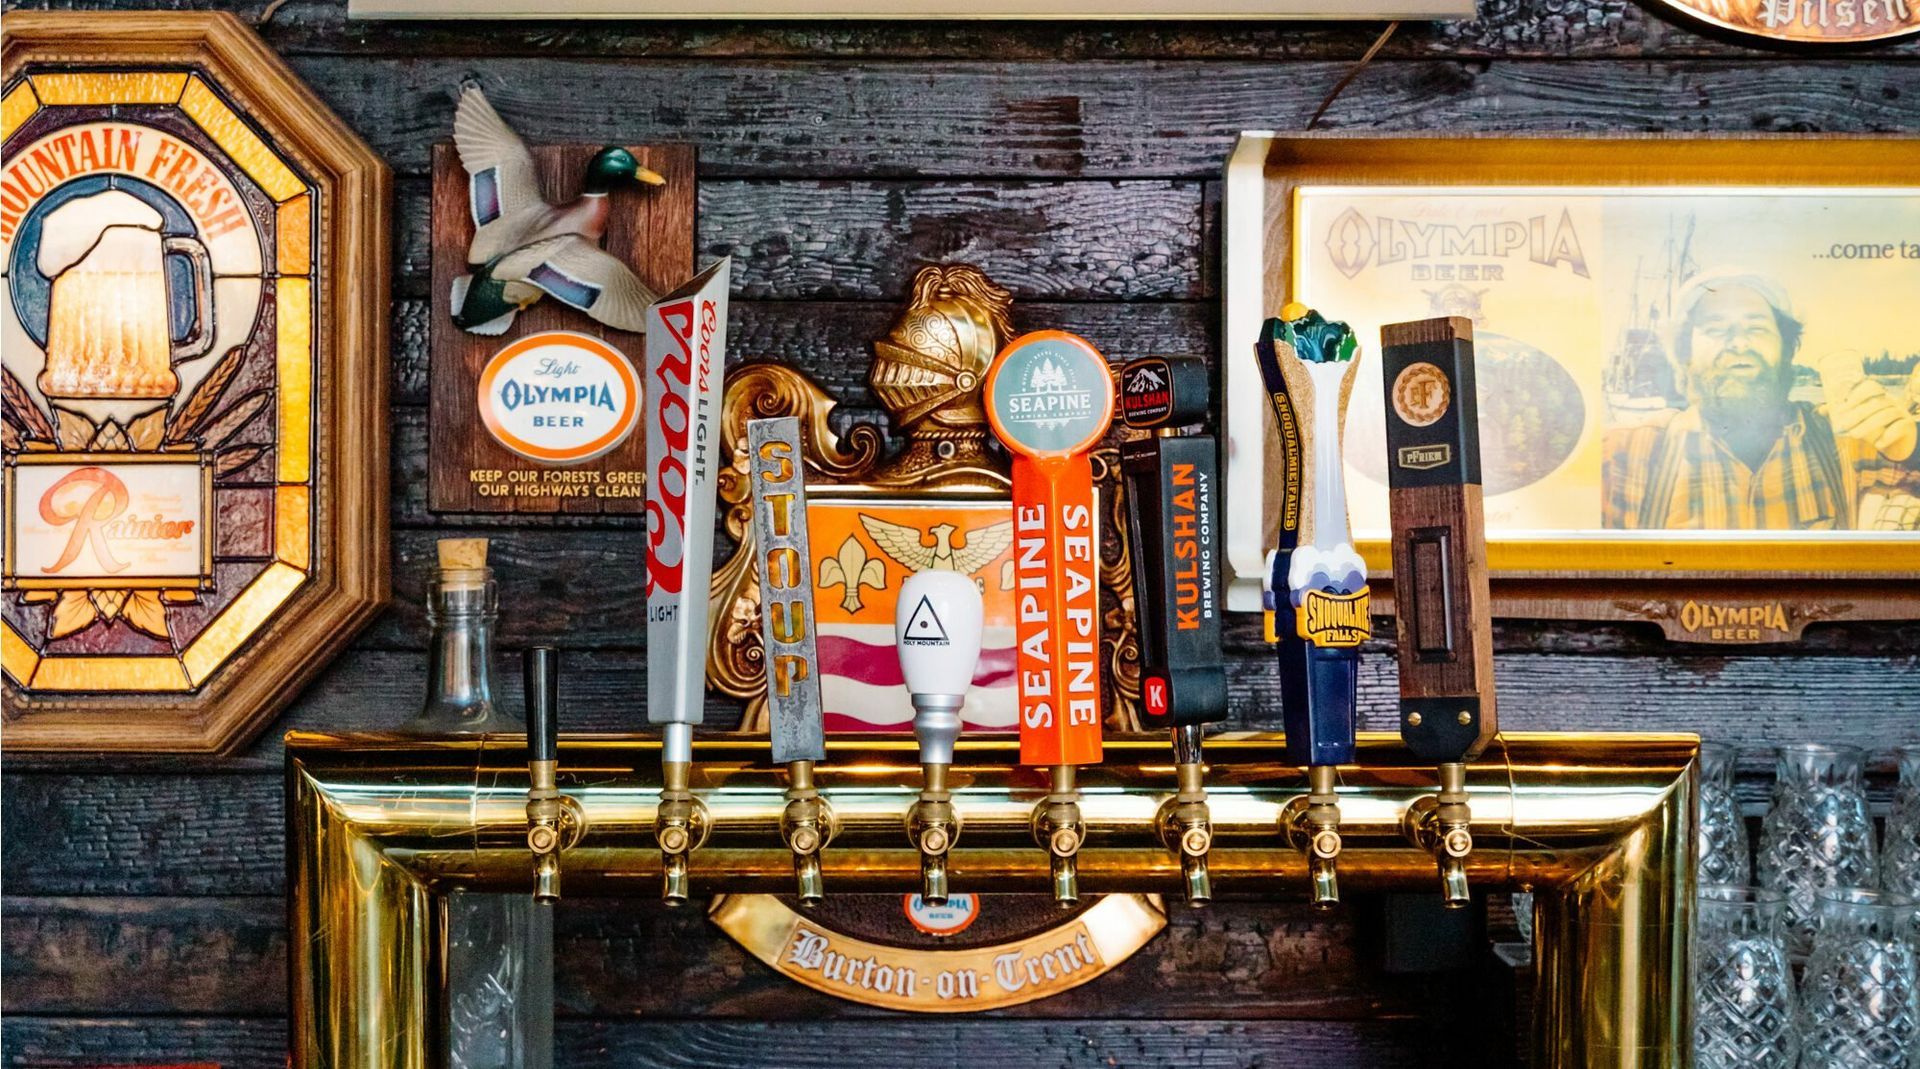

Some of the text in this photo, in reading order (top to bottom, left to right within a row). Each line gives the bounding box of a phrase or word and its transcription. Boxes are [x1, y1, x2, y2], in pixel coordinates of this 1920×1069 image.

[146, 139, 247, 242] FRESH
[1324, 206, 1591, 280] OLYMPIA
[1411, 264, 1504, 280] BEER
[535, 358, 581, 378] Light
[501, 378, 616, 412] OLYMPIA
[696, 299, 717, 482] Coors LIGHT
[1009, 393, 1091, 413] SEAPINE
[1125, 391, 1169, 409] KULSHAN
[533, 416, 584, 427] BEER
[1276, 394, 1298, 529] SNOQUALMIE FALLS
[470, 470, 502, 482] KEEP
[508, 471, 538, 482] OUR
[543, 471, 600, 483] FORESTS
[479, 484, 641, 497] OUR HIGHWAYS CLEAN
[38, 467, 195, 573] Rainier
[1172, 463, 1201, 630] KULSHAN
[1200, 472, 1213, 619] BREWING COMPANY
[650, 605, 678, 622] LIGHT
[1018, 504, 1053, 729] SEAPINE
[1062, 504, 1096, 727] SEAPINE
[1681, 600, 1789, 633] OLYMPIA
[1326, 629, 1359, 641] FALLS
[1712, 629, 1760, 640] BEER
[1149, 685, 1164, 707] K
